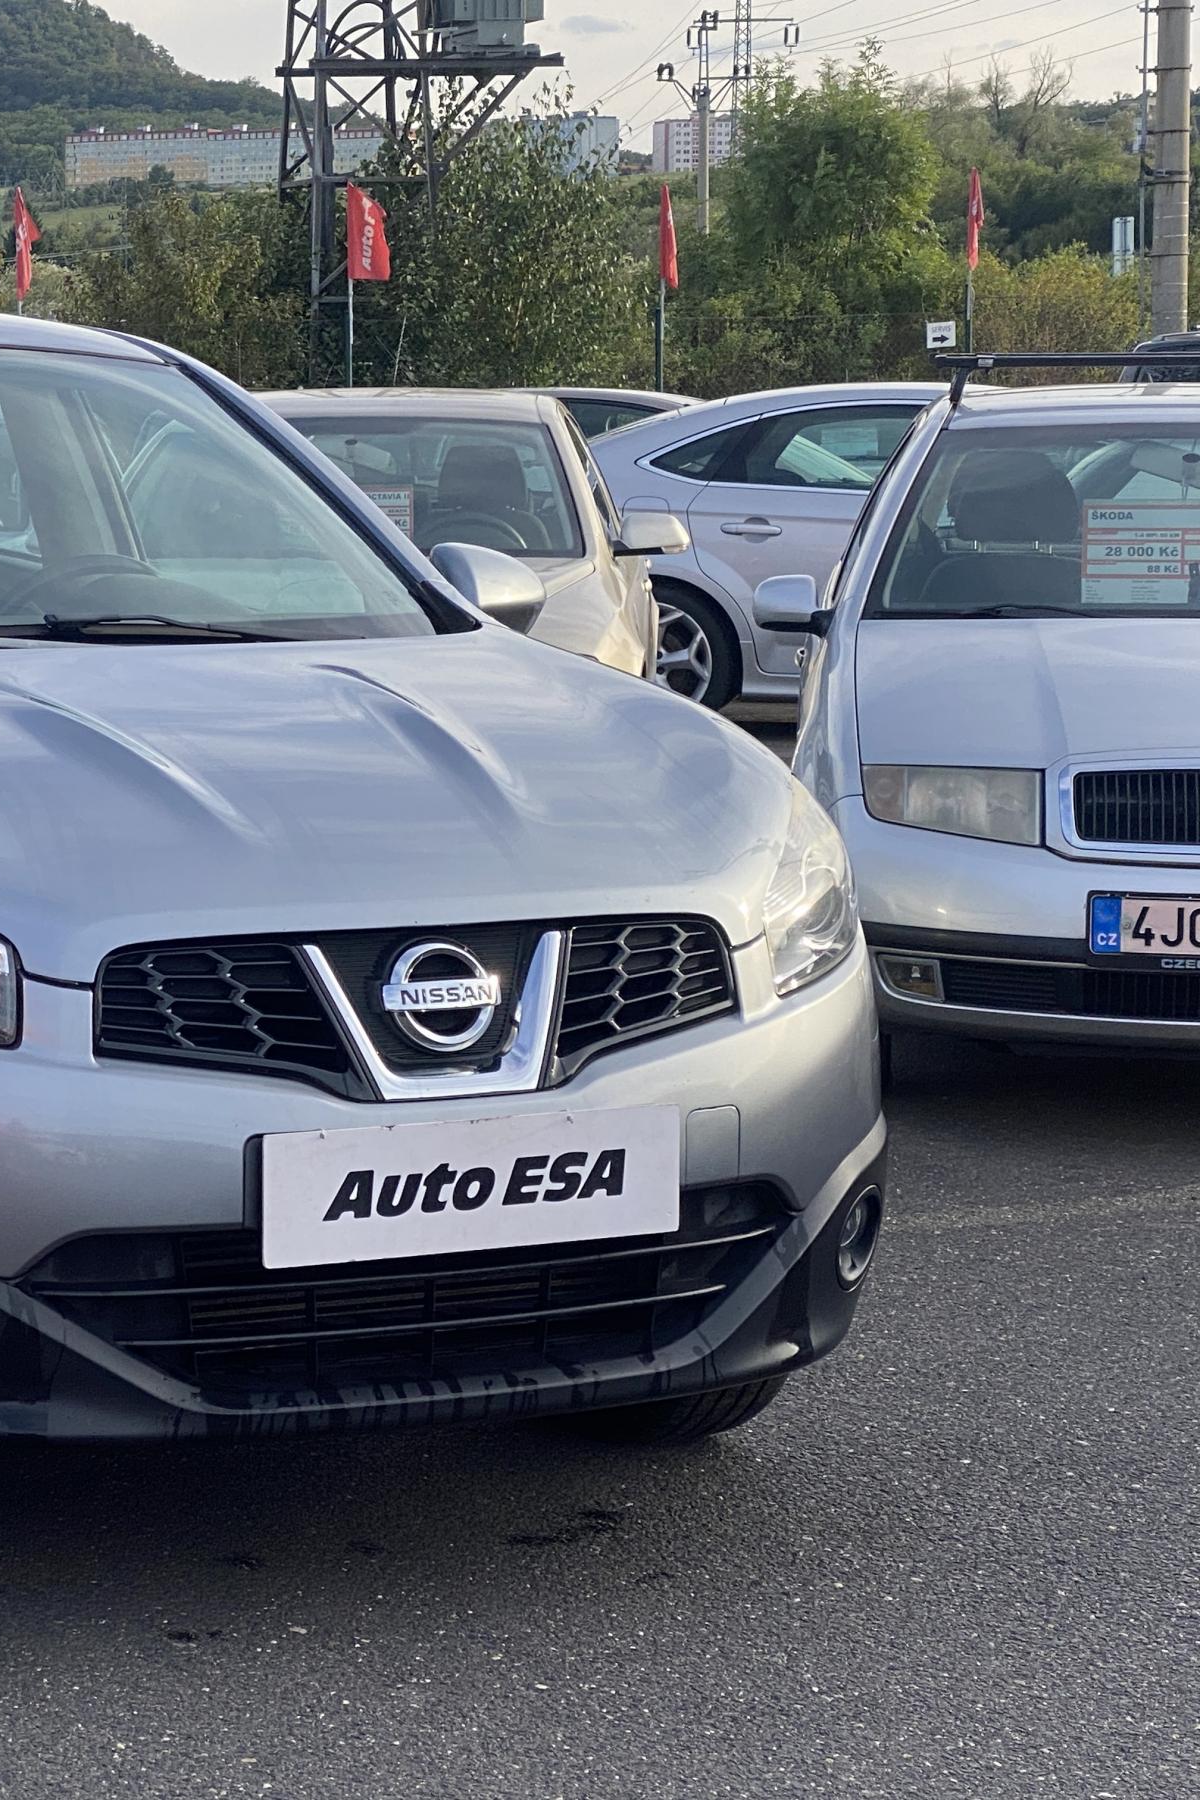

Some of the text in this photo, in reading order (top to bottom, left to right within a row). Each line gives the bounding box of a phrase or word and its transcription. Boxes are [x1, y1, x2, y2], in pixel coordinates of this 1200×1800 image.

[362, 225, 374, 271] Auto
[931, 325, 952, 333] SERVIS
[1091, 510, 1134, 521] ŠKODA
[1105, 546, 1179, 557] 28 000 Kč
[1164, 565, 1179, 573] Kč
[1097, 933, 1117, 946] CZ
[1161, 959, 1200, 969] CZE
[400, 984, 492, 1006] NISSAN
[322, 1148, 626, 1222] Auto ESA
